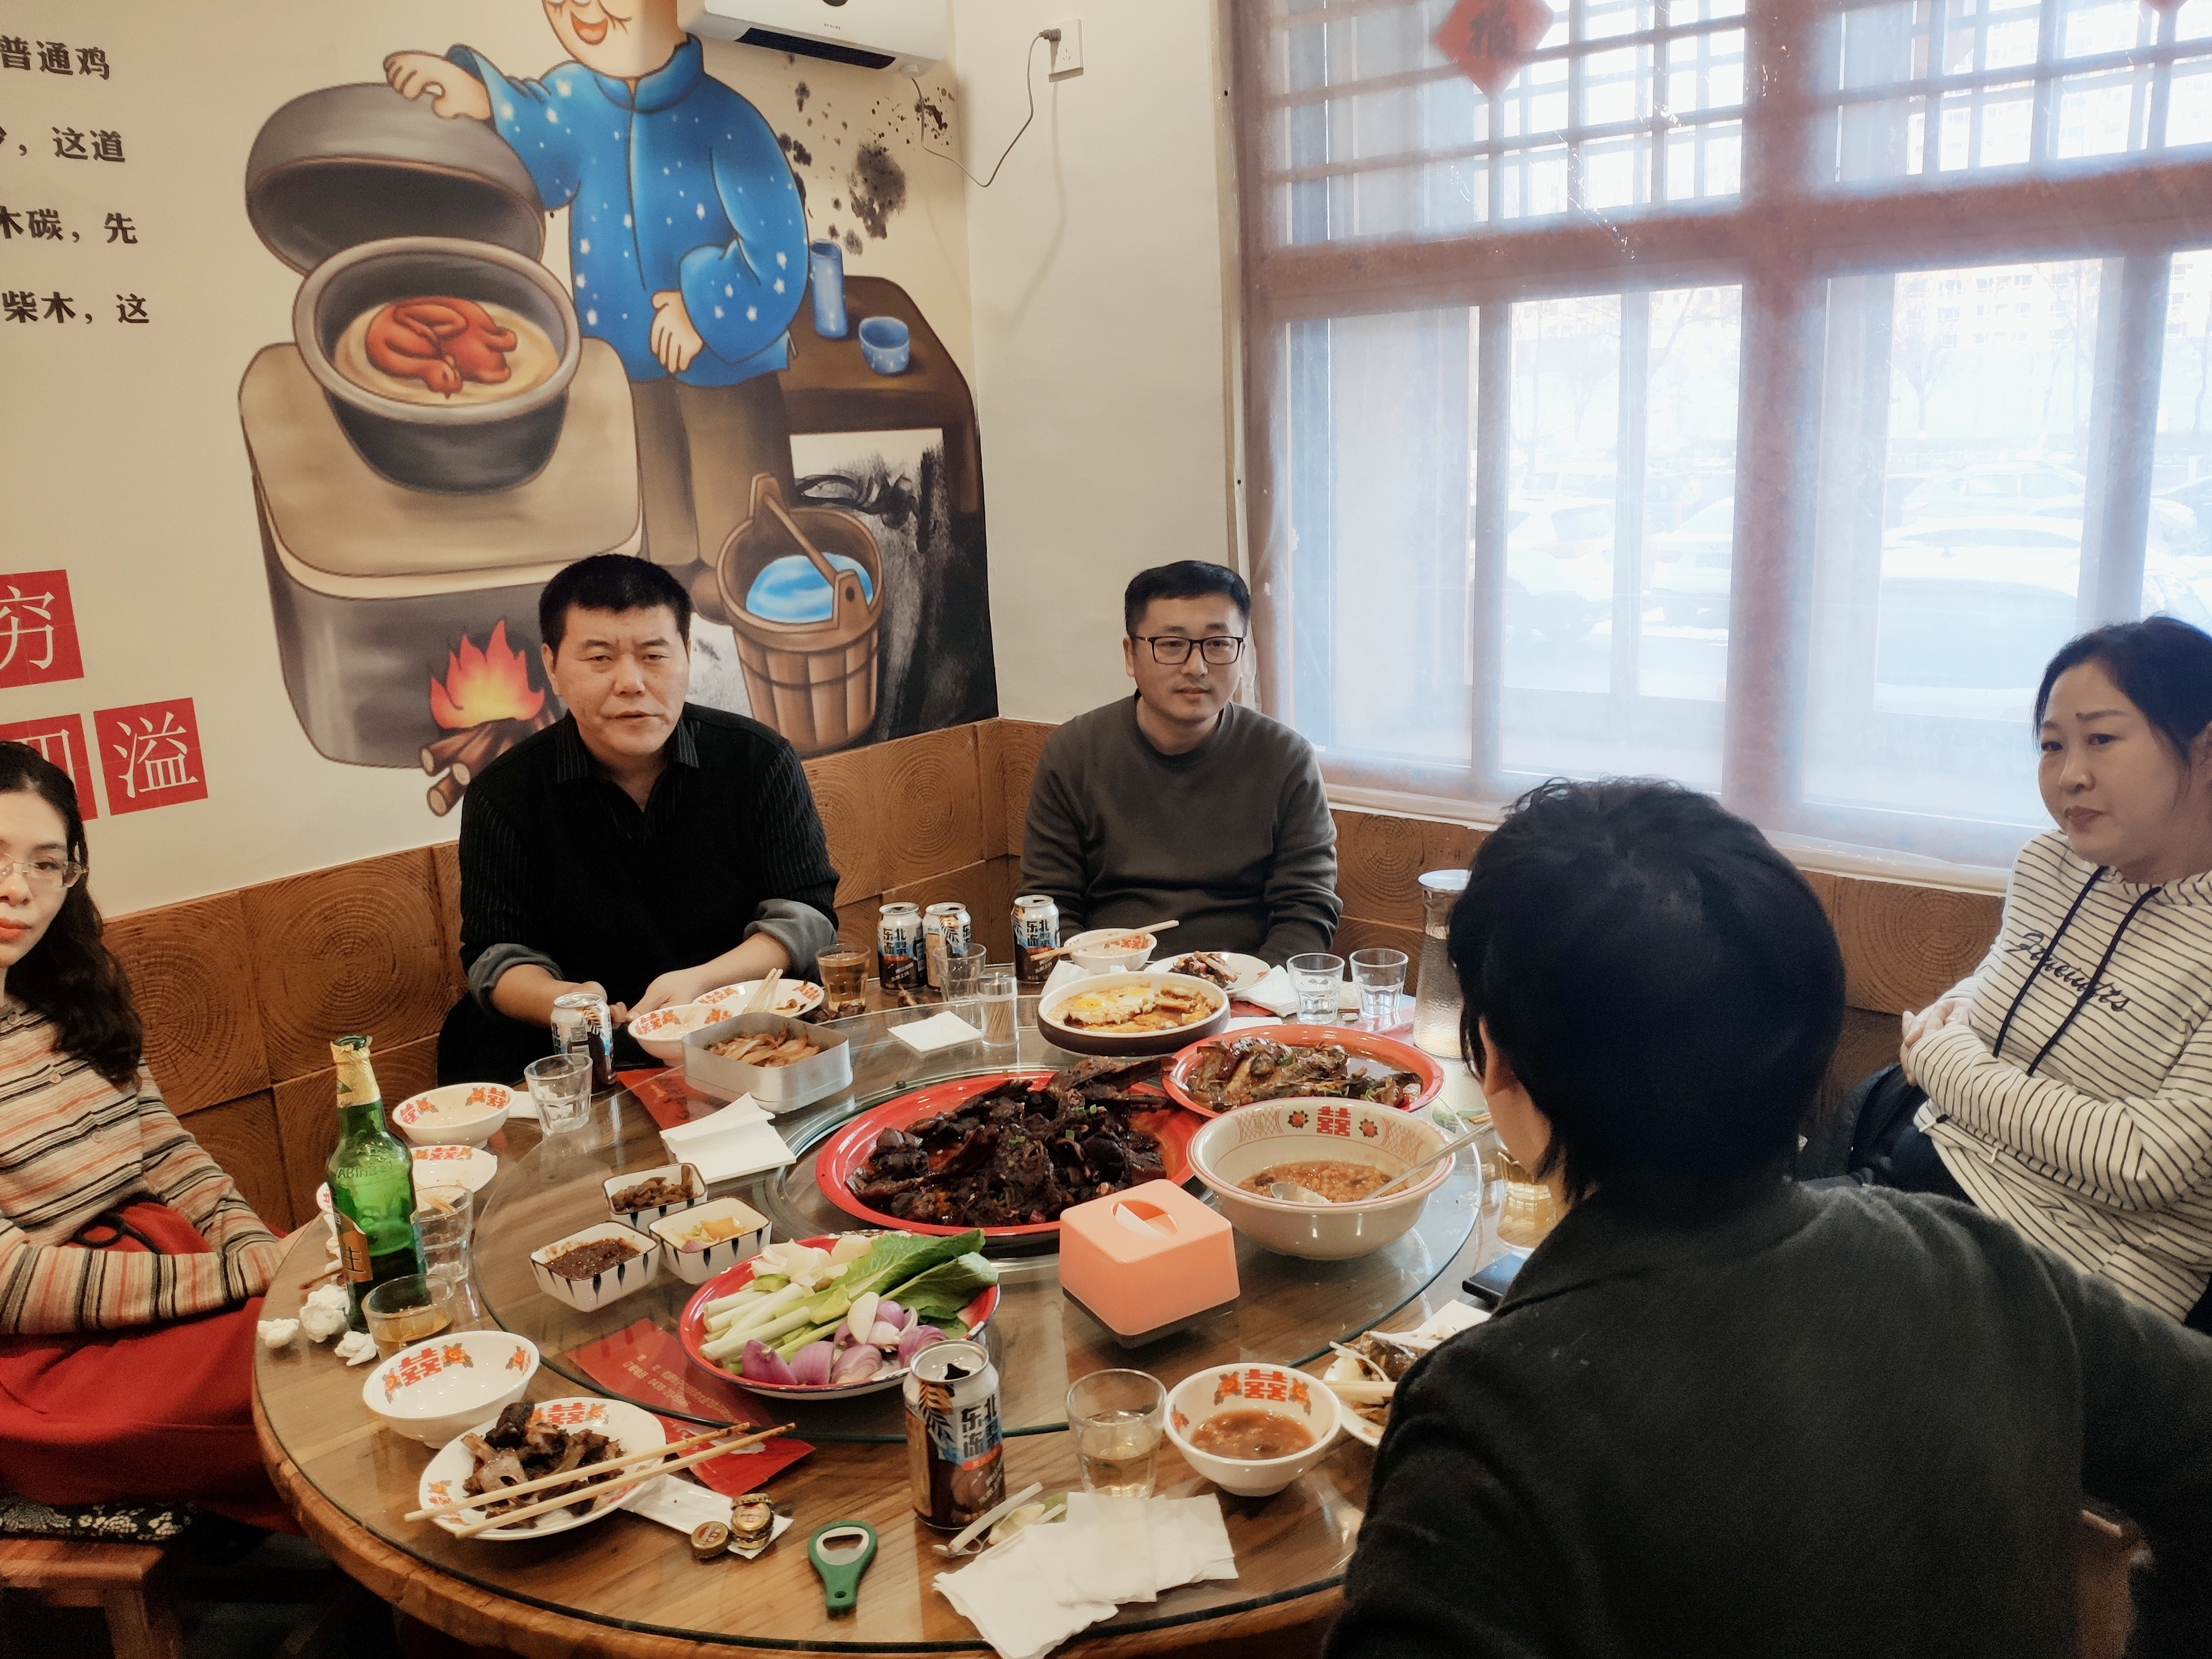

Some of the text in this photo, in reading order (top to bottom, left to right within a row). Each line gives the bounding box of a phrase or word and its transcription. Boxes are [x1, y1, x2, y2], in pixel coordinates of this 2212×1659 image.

[0, 35, 110, 80] 普通鸡
[0, 126, 125, 162] ，这道
[2, 290, 149, 324] 柴木，这
[0, 585, 55, 670] 穷
